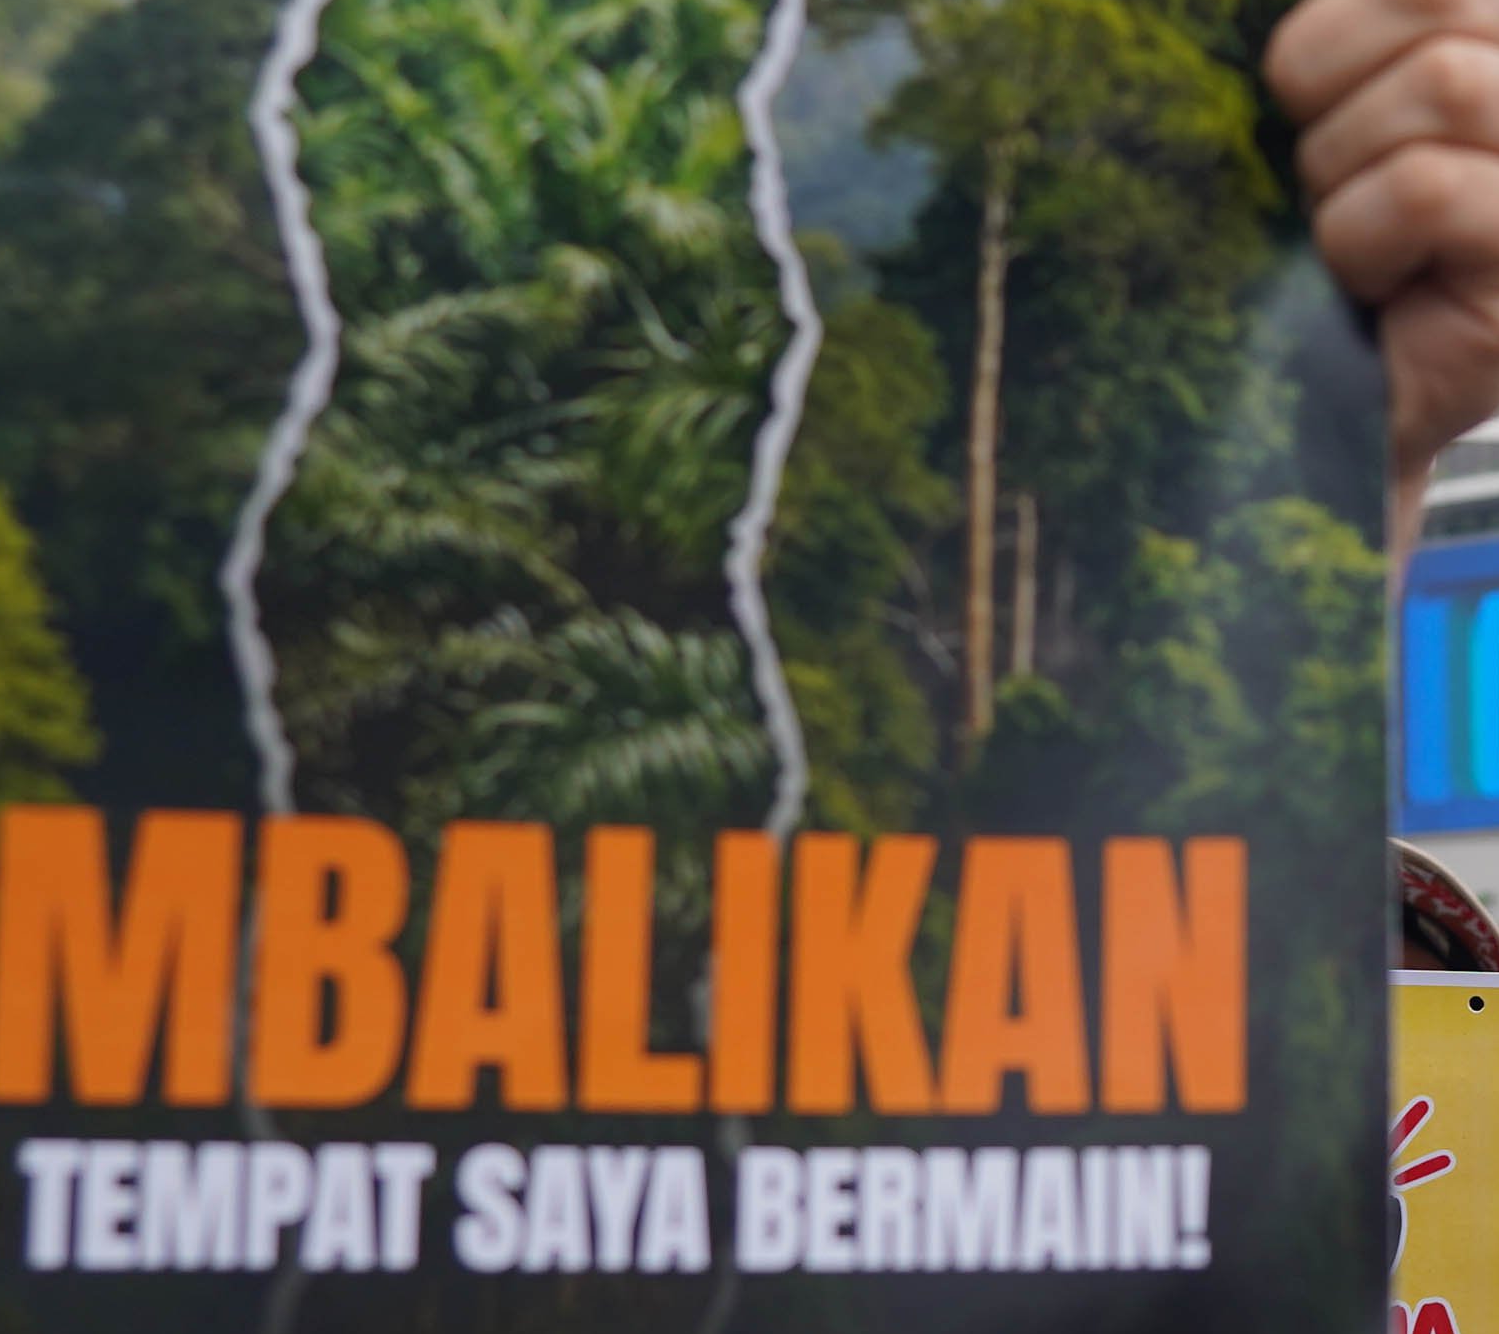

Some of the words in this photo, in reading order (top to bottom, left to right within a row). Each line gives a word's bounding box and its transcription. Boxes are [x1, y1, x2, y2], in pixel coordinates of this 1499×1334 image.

[17, 1140, 436, 1271] TEMPAT
[452, 1143, 711, 1271] SAYA
[734, 1144, 1214, 1271] BERMAIN!
